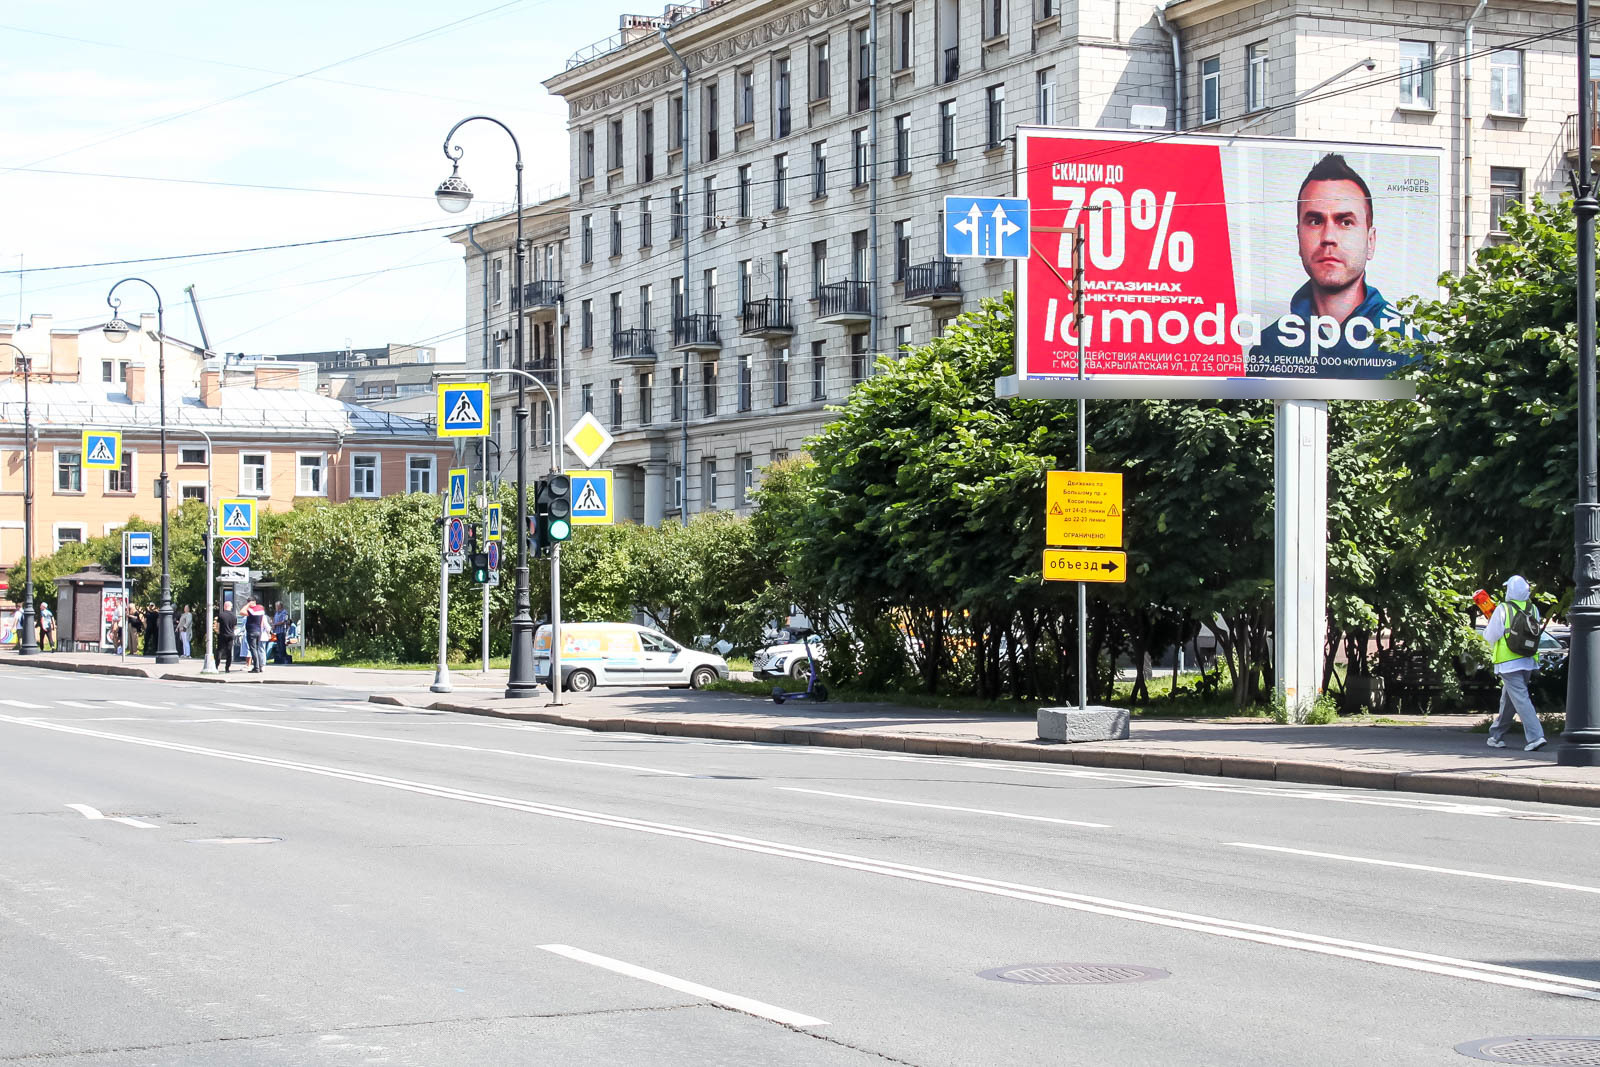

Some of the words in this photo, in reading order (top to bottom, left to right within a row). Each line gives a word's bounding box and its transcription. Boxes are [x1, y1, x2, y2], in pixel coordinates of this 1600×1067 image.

[1052, 163, 1103, 183] СКИДКИ
[1105, 165, 1124, 184] ДО
[1387, 185, 1429, 193] АКИНФЕЕВ
[1052, 186, 1194, 272] 70%
[1083, 281, 1182, 292] МАГАЗИНАХ
[1044, 298, 1261, 347] lamoda
[1085, 351, 1137, 361] ДЕЙСТВИЯ
[1139, 352, 1172, 362] АКЦИИ
[1174, 353, 1181, 362] С
[1183, 354, 1214, 363] 1.07.24
[1216, 354, 1230, 363] ПО
[1274, 356, 1319, 365] РЕКЛАМА
[1321, 357, 1341, 366] ООО
[1343, 358, 1397, 367] «КУПИШУЗ»
[1216, 364, 1241, 372] ОГРН
[1050, 558, 1098, 571] объезд
